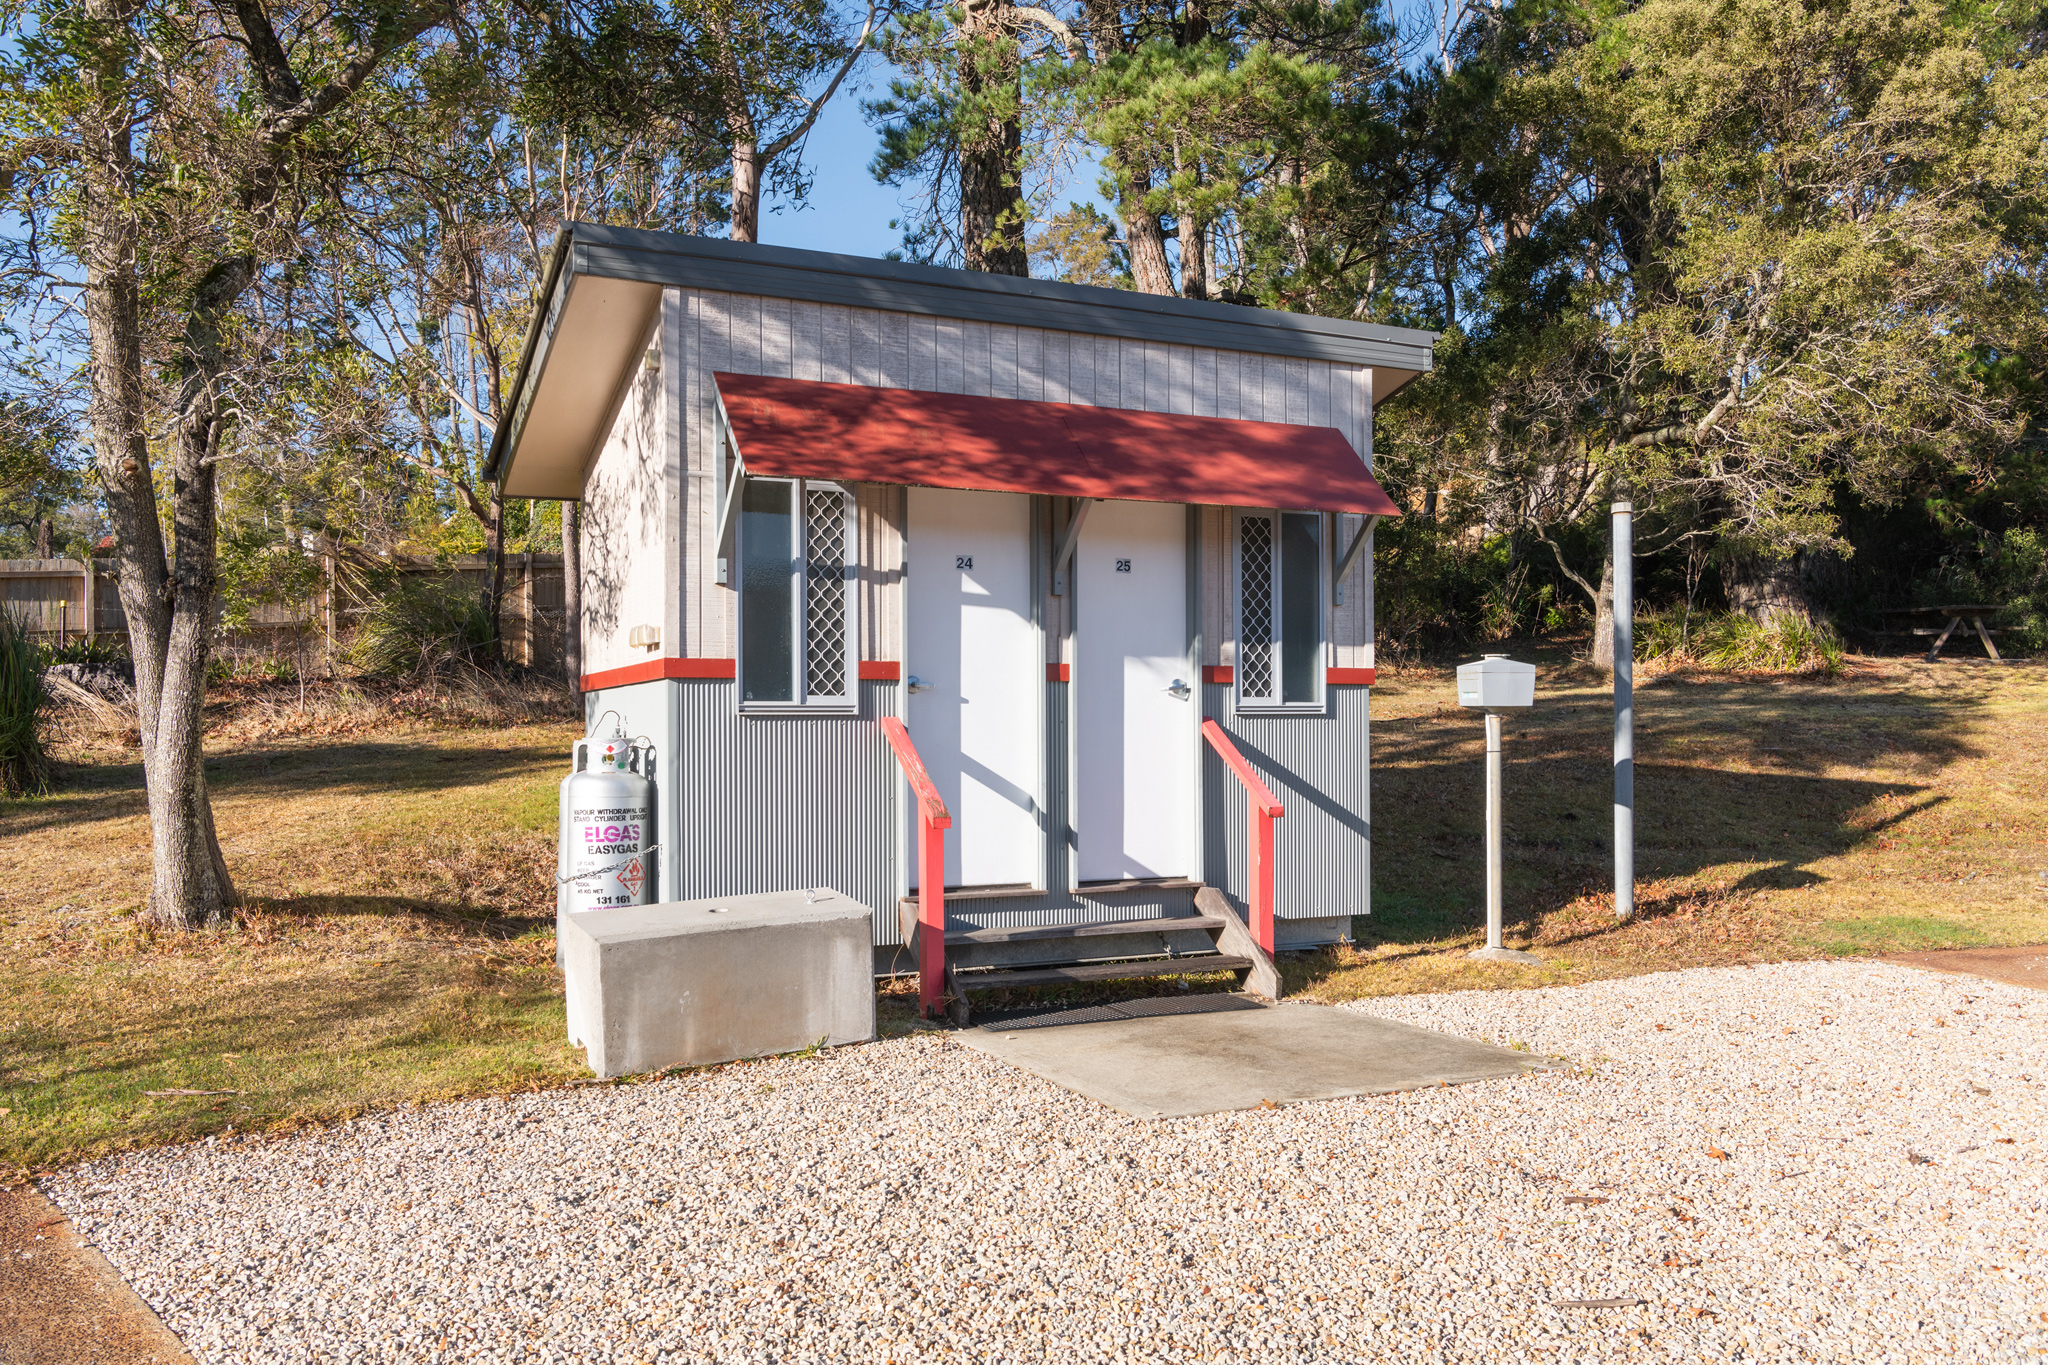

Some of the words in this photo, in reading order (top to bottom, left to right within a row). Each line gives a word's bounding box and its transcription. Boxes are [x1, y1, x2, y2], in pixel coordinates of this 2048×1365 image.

[956, 557, 973, 570] 24
[1116, 560, 1131, 572] 25
[585, 824, 640, 843] ELGAS
[588, 843, 638, 854] EASYGAS
[615, 895, 630, 903] 161
